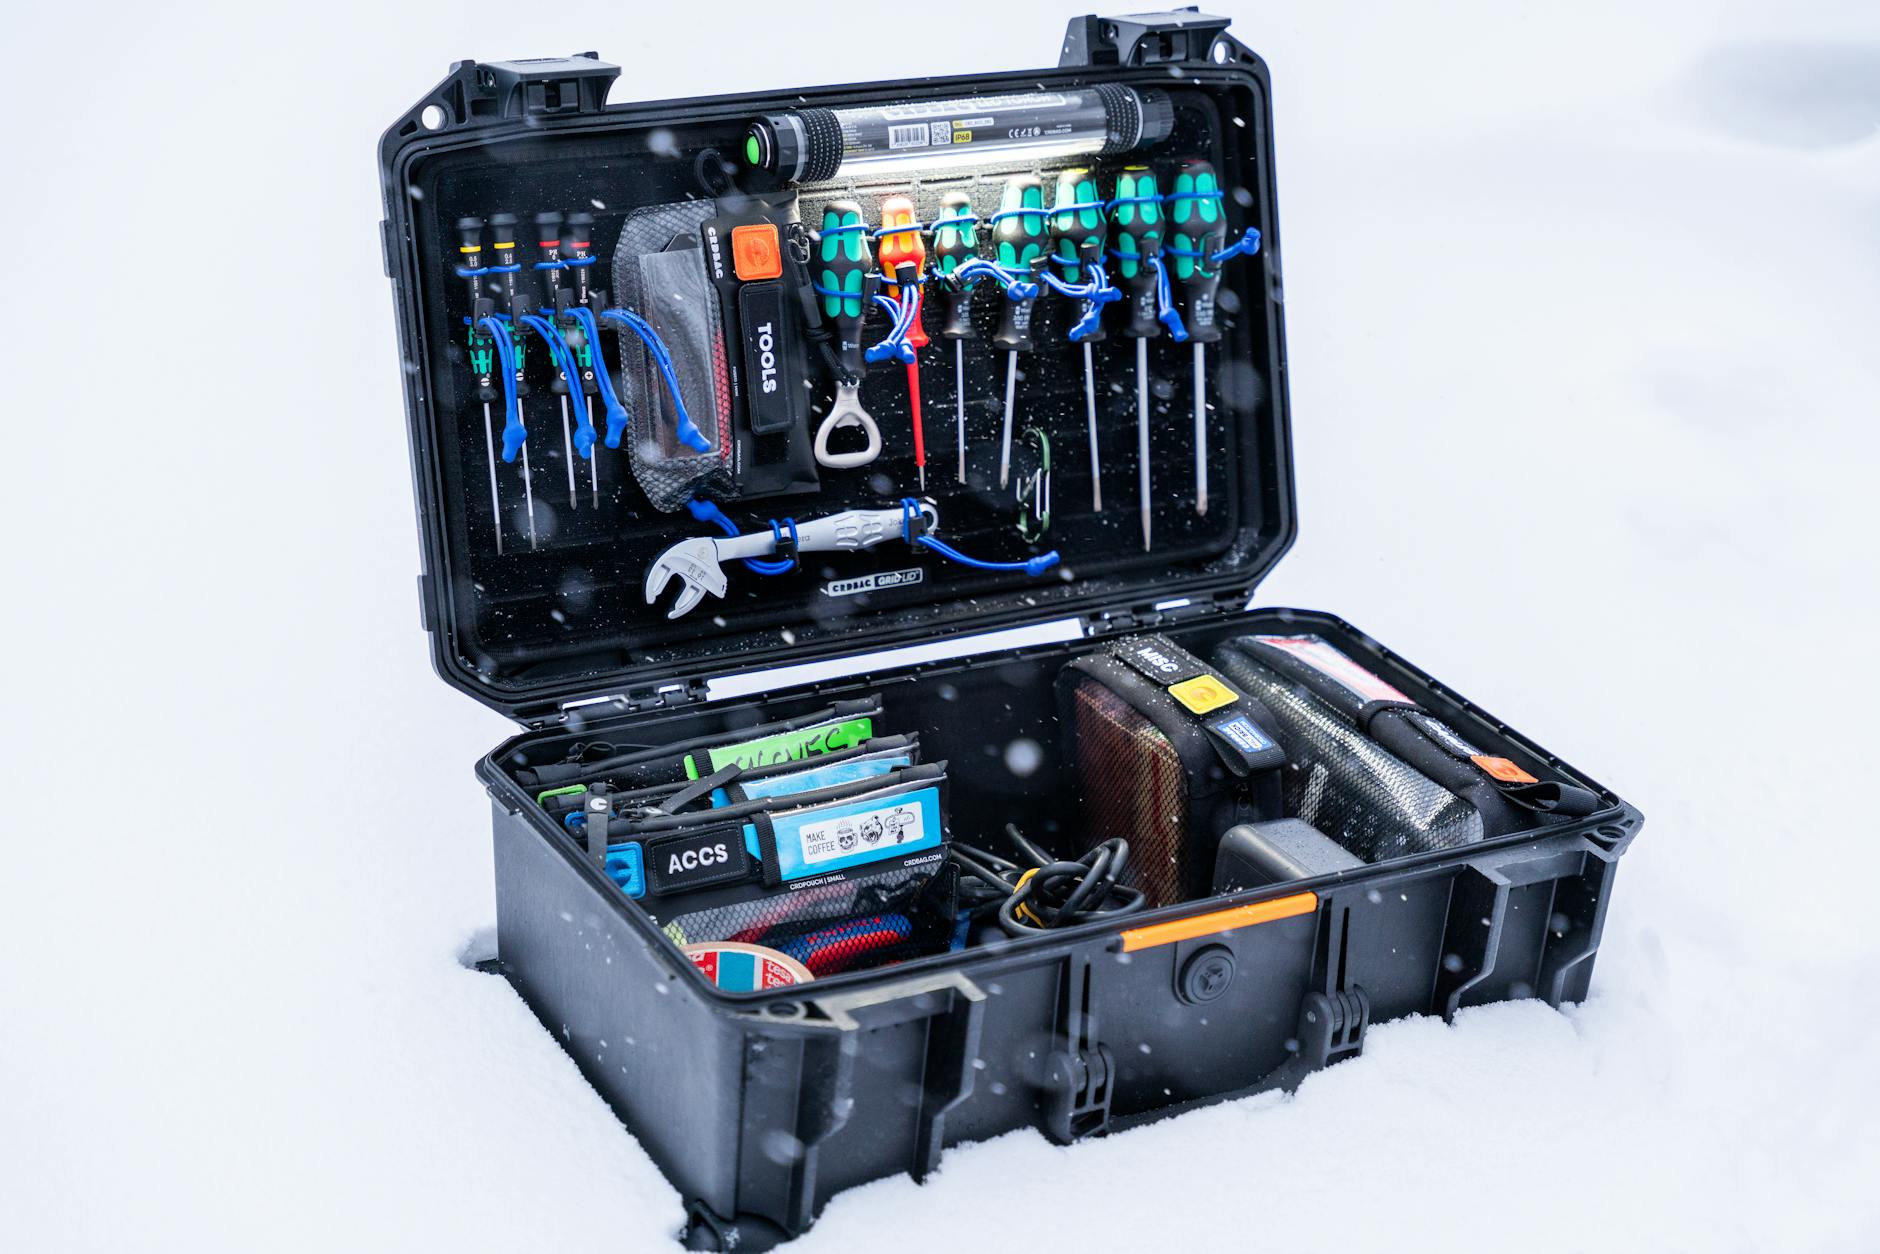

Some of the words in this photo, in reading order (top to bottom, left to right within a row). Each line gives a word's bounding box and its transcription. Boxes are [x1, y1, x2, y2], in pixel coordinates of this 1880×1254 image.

[955, 132, 970, 142] IP68
[757, 322, 777, 394] TOOLS
[1136, 647, 1179, 672] MISC
[806, 831, 826, 843] MAKE
[807, 840, 836, 856] COFFEE
[668, 843, 728, 875] ACCS
[903, 854, 943, 867] CRDBAG.COM
[789, 877, 824, 890] CRDPOUCH
[826, 874, 846, 883] SMALL
[765, 960, 790, 984] tesa
